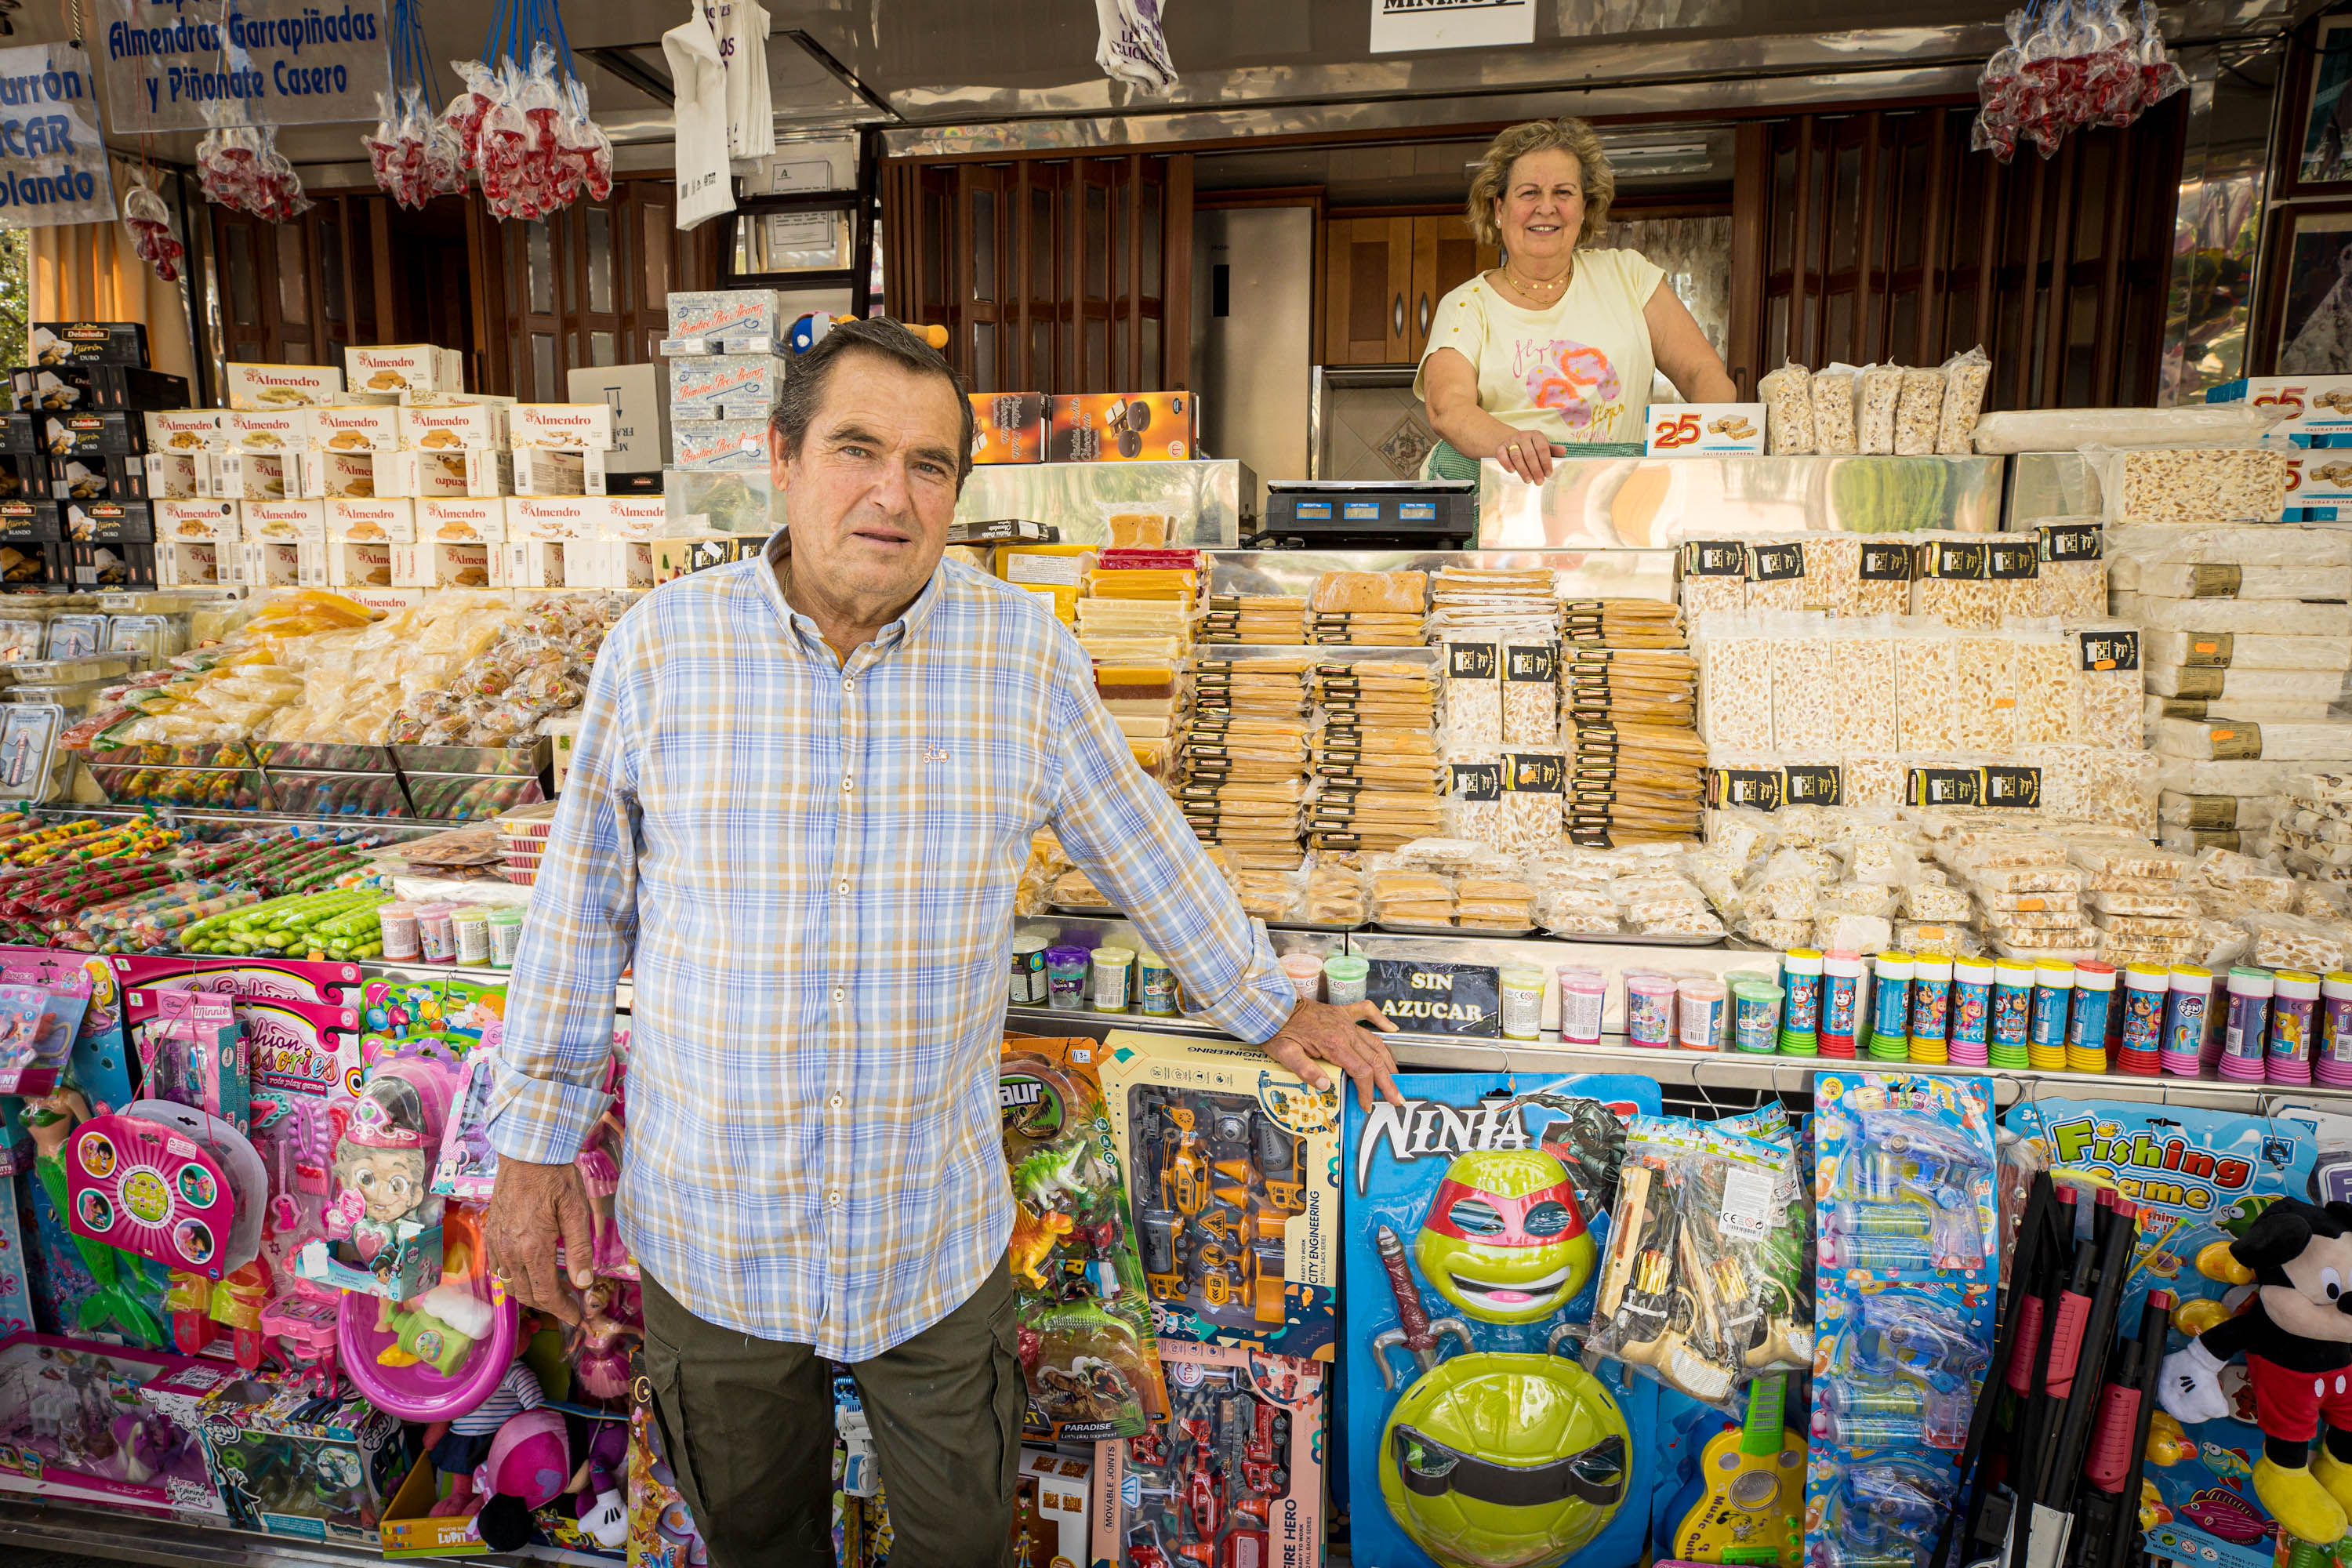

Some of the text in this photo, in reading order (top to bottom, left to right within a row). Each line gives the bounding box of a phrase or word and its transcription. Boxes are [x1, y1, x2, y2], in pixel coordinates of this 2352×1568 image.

[108, 5, 376, 61] Almendras Garrapiñadas
[1, 59, 82, 106] urrón
[146, 60, 347, 114] y Piñonate Casero
[0, 114, 75, 158] CAR
[367, 358, 415, 368] Almendro
[256, 376, 320, 387] Almendro
[165, 421, 212, 430] Almendro
[241, 420, 289, 430] Almendro
[328, 419, 378, 427] Almendro
[419, 416, 470, 426] Almendro
[534, 416, 591, 426] Almendro
[1081, 413, 1091, 460] Chocolate
[1654, 413, 1702, 449] 25
[174, 509, 220, 518] Almendro
[260, 510, 307, 519] Almendro
[346, 510, 394, 518] Almendro
[436, 510, 485, 518] Almendro
[528, 506, 580, 517] Almendro
[618, 506, 665, 517] Almendr
[1411, 972, 1454, 991] SIN
[195, 1007, 228, 1017] Minnie
[1383, 998, 1483, 1022] AZUCAR
[1187, 1047, 1269, 1058] ENGINEERING
[270, 1077, 325, 1093] role play games
[1767, 1105, 1781, 1120] Toy
[1735, 1118, 1754, 1130] Toy
[1359, 1100, 1530, 1193] NINJA
[1723, 1137, 1744, 1147] Toy
[1762, 1149, 1784, 1159] Toy
[2053, 1120, 2251, 1188] Fishing
[1309, 1191, 1319, 1283] CITY ENGINEERING
[1065, 1423, 1112, 1432] PARADISE
[171, 1476, 195, 1488] Horse
[174, 1483, 206, 1499] Training
[180, 1492, 201, 1502] Court
[1698, 1496, 1725, 1529] Music
[1284, 1499, 1297, 1540] HERO
[438, 1532, 466, 1544] LUPIT
[2152, 1544, 2170, 1554] MADE
[2178, 1551, 2198, 1562] CHINA
